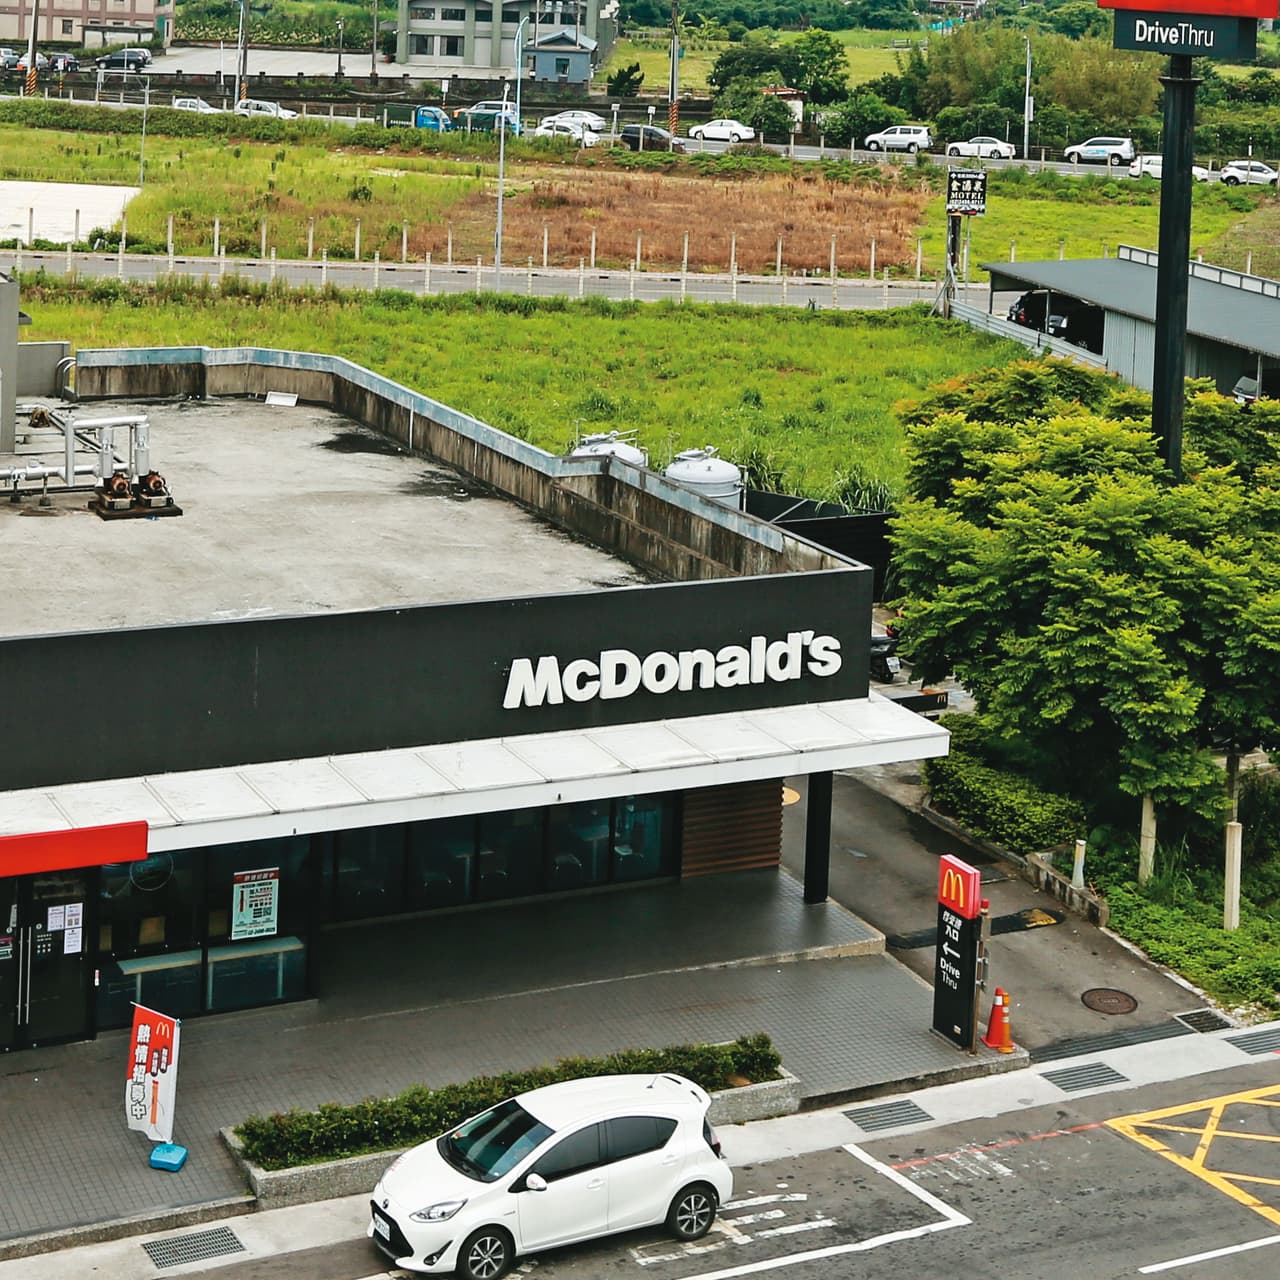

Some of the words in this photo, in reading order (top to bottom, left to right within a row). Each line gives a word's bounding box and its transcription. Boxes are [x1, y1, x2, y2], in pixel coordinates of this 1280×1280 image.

[1135, 19, 1215, 48] DriveThru
[950, 192, 984, 200] MOTEL
[503, 630, 842, 709] McDonald's
[940, 957, 961, 979] Drive
[941, 970, 958, 990] Thru
